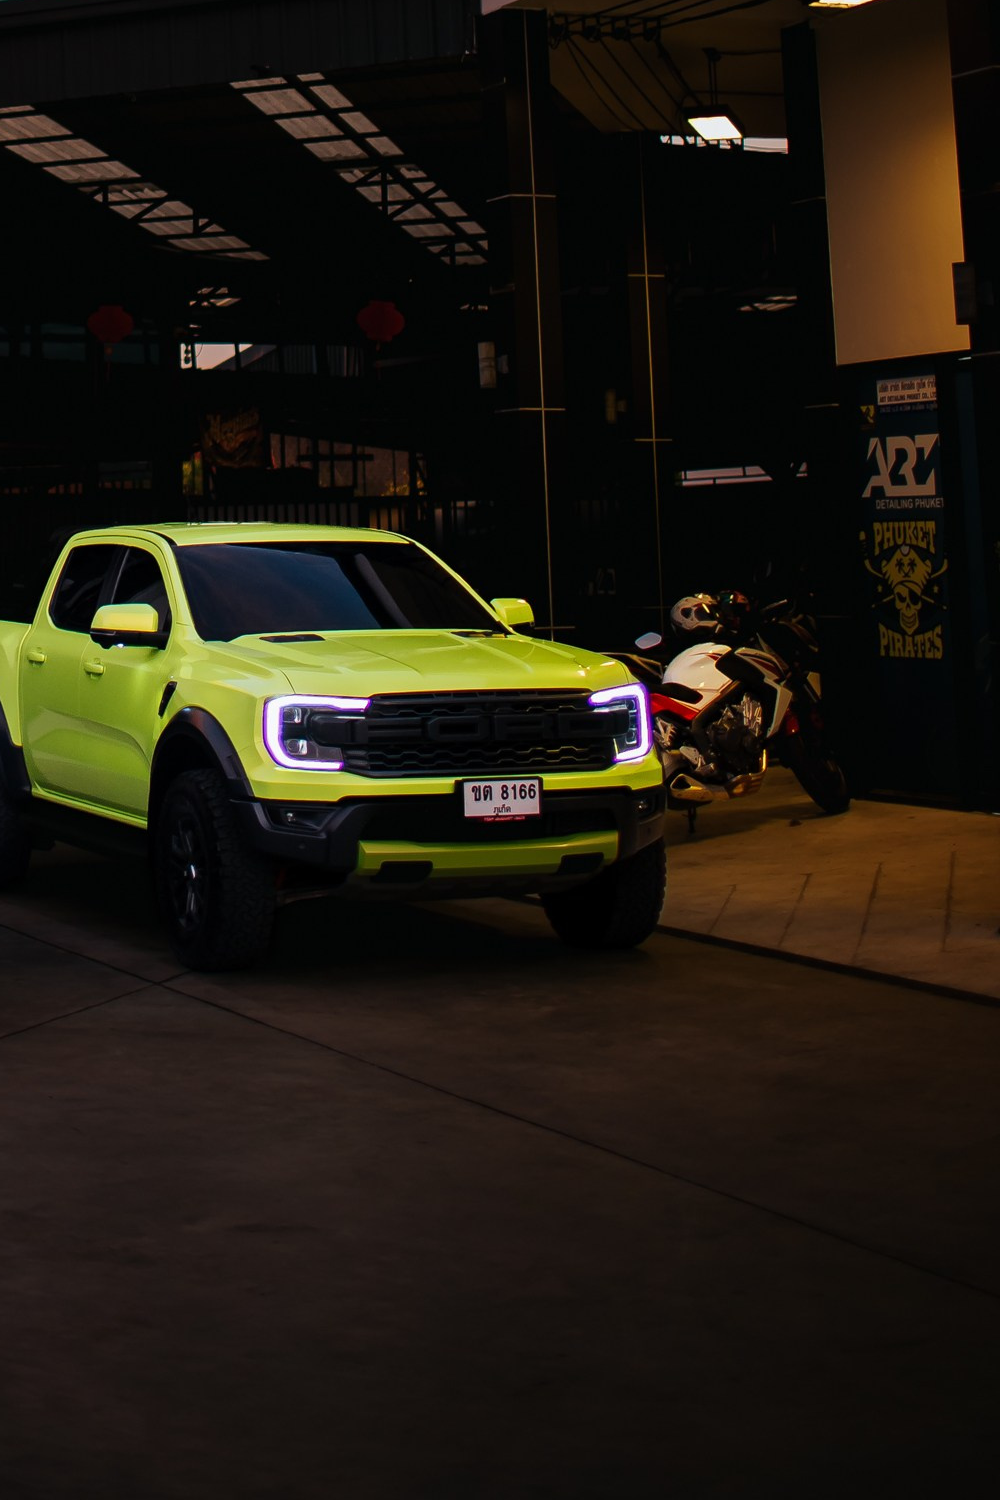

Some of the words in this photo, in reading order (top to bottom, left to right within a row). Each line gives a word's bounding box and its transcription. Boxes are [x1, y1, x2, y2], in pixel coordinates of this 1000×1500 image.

[875, 498, 914, 510] DETAILING
[914, 497, 944, 509] PHUKET
[872, 520, 936, 557] PHUKET
[878, 620, 945, 661] PIRATES
[346, 713, 617, 746] FORD
[500, 783, 537, 801] 8166
[493, 803, 512, 816] ภูเก็ต
